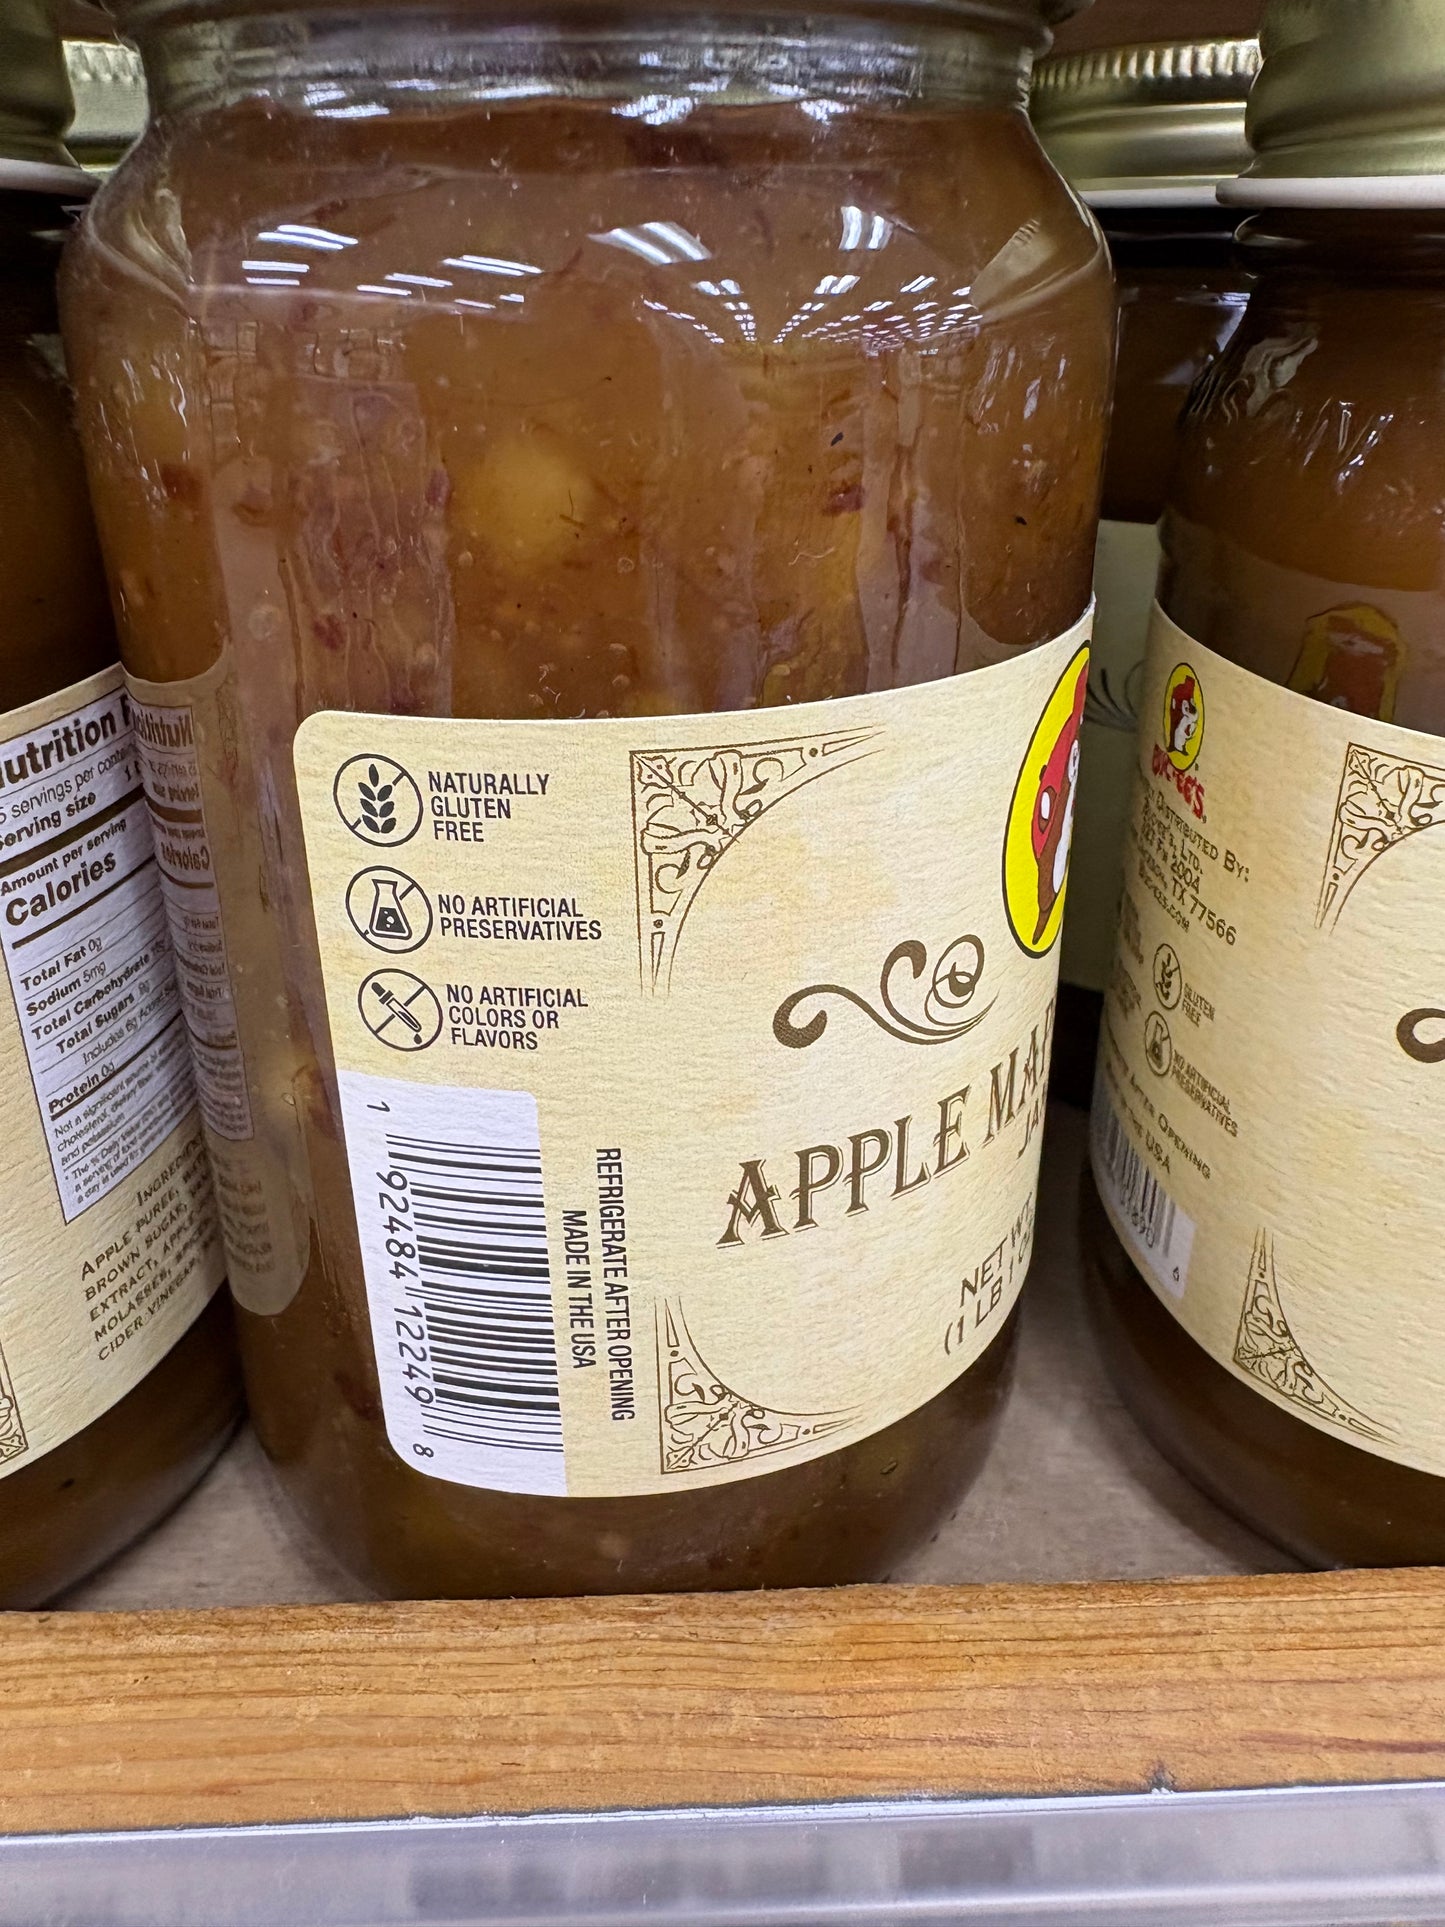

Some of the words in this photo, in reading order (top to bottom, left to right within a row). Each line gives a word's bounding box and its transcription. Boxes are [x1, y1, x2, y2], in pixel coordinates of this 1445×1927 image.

[0, 710, 117, 790] utrition
[11, 779, 73, 818] servings
[75, 766, 96, 791] per
[428, 771, 549, 795] NATURALLY
[431, 796, 512, 819] GLUTEN
[0, 857, 59, 896] Amount
[61, 845, 84, 867] per
[86, 818, 127, 851] serving
[434, 821, 484, 842] FREE
[5, 852, 117, 926] Calories
[438, 894, 465, 914] NO
[472, 897, 583, 917] ARTIFICIAL
[441, 918, 602, 940] PRESERVATIVES
[1188, 894, 1238, 946] 77566
[20, 960, 61, 991] Total
[64, 944, 87, 968] Fat
[26, 977, 82, 1017] Sodium
[83, 961, 107, 984] 5mg
[31, 1008, 71, 1040] Total
[73, 953, 150, 1016] Carbohydrate
[446, 984, 473, 1004] NO
[480, 987, 588, 1007] ARTIFICIAL
[449, 1007, 525, 1027] COLORS
[533, 1010, 559, 1029] OR
[56, 1021, 93, 1054] Total
[95, 993, 135, 1029] Sugars
[451, 1028, 538, 1050] FLAVORS
[49, 1073, 101, 1113] Protein
[54, 1120, 73, 1138] Not
[715, 1084, 971, 1249] APPLE
[377, 1170, 418, 1280] 92484
[563, 1209, 590, 1265] MADE
[596, 1148, 628, 1278] REFRIGERATE
[82, 1231, 132, 1281] APPLE
[85, 1247, 141, 1302] BROWN
[567, 1269, 591, 1289] IN
[959, 1236, 1008, 1308] NET
[90, 1256, 158, 1322] EXTRACT,
[569, 1294, 593, 1329] THE
[605, 1282, 630, 1340] AFTER
[975, 1280, 1003, 1329] LB
[98, 1318, 145, 1361] CIDER
[394, 1306, 435, 1405] 12249
[572, 1335, 596, 1369] USA
[608, 1344, 635, 1421] OPENING
[412, 1443, 434, 1458] 8
